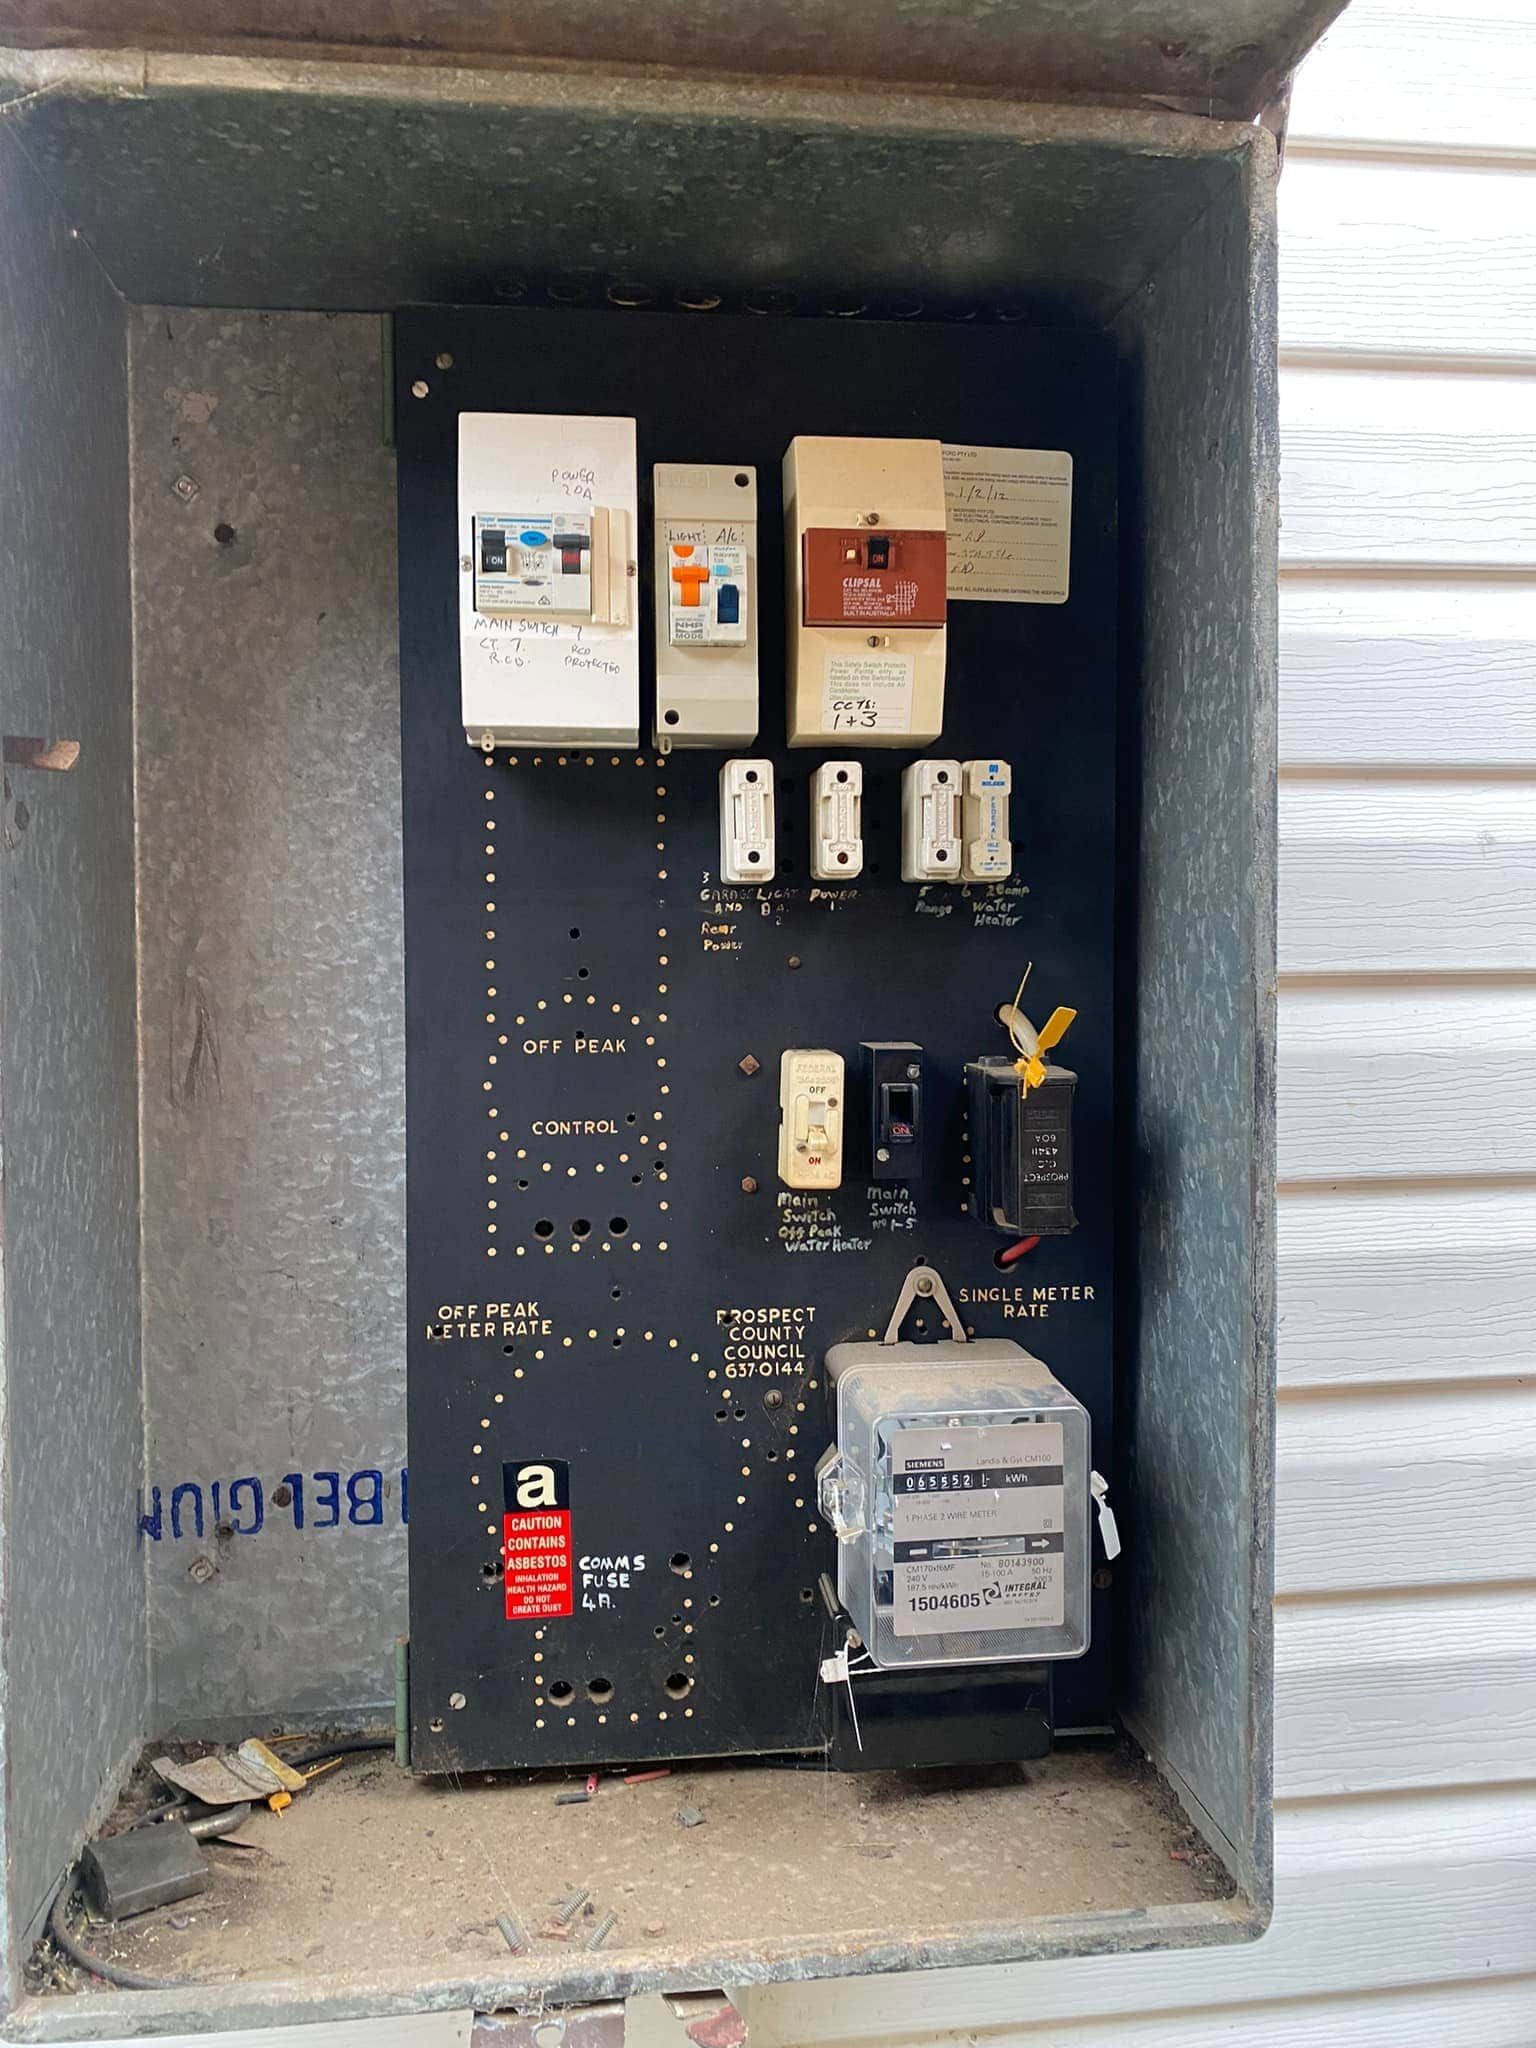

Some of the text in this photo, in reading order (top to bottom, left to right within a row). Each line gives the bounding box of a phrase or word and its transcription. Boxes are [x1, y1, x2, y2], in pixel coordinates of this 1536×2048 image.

[552, 467, 595, 486] POWER
[562, 484, 592, 500] 20A
[668, 529, 702, 542] LIGHT
[716, 527, 737, 544] A/C
[491, 556, 503, 565] ON
[873, 554, 884, 563] ON
[843, 578, 881, 588] CLIPSAL
[474, 618, 512, 632] MAIN
[519, 618, 559, 637] SWITCH
[714, 901, 743, 914] AND
[523, 1039, 627, 1054] OFF PEAK
[809, 1086, 826, 1094] OFF
[532, 1120, 618, 1135] CONTROL
[892, 1124, 910, 1135] ON
[808, 1156, 821, 1165] ON
[1023, 1172, 1069, 1182] PROSPECT
[777, 1191, 818, 1208] Main
[867, 1184, 908, 1200] Main
[959, 1286, 1096, 1303] SINGLE METER
[438, 1302, 539, 1320] OFF PEAK
[1004, 1305, 1049, 1319] RATE
[503, 1320, 552, 1336] RATE
[729, 1326, 805, 1341] COUNTY
[724, 1344, 805, 1360] COUNCIL
[906, 1459, 944, 1469] SIEMENS
[1005, 1474, 1028, 1483] kWh
[516, 1464, 558, 1509] a
[511, 1516, 562, 1531] CAUTION
[912, 1513, 937, 1522] PHASE
[947, 1512, 968, 1520] WIRE
[970, 1510, 997, 1519] METER
[507, 1535, 566, 1551] CONTAINS
[507, 1554, 567, 1570] ASBESTOS
[578, 1555, 646, 1571] COMMS
[515, 1573, 559, 1583] INHALATION
[582, 1573, 630, 1589] FUSE
[906, 1575, 921, 1583] 240
[507, 1583, 567, 1595] HEALTH HAZARD
[1004, 1581, 1047, 1592] INTEGRAL
[523, 1594, 551, 1604] DO NOT
[909, 1593, 980, 1612] 1504605
[512, 1603, 562, 1614] CREATE DUST
